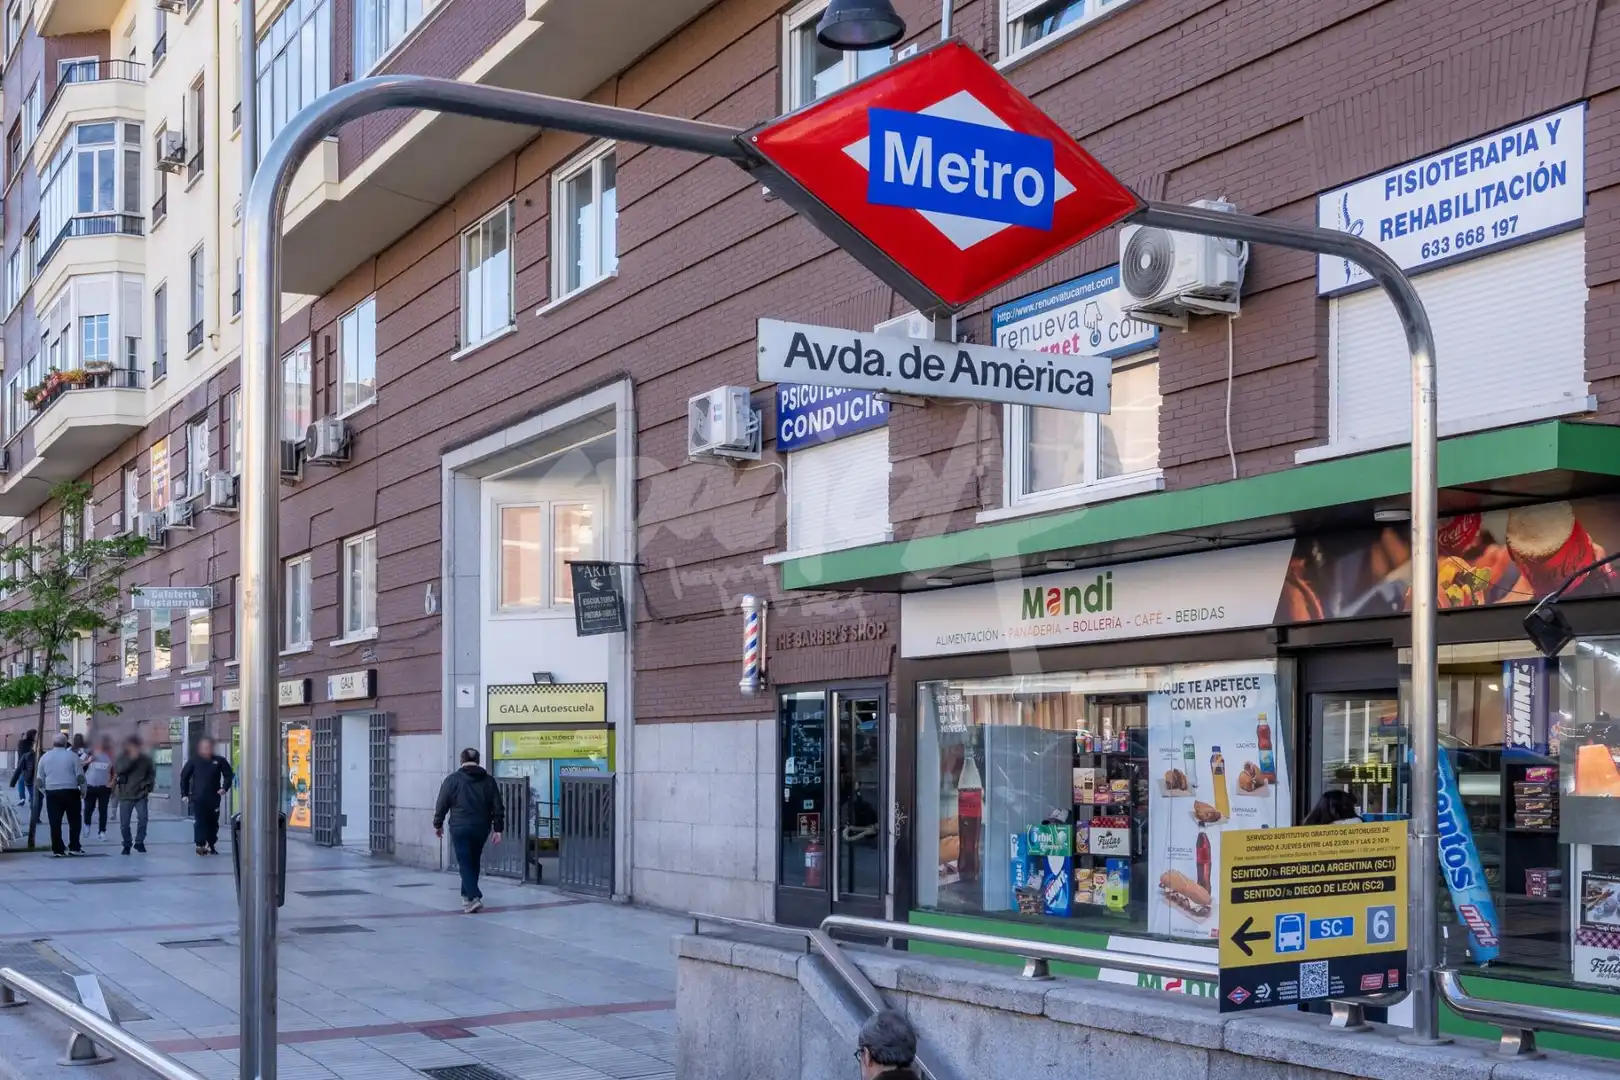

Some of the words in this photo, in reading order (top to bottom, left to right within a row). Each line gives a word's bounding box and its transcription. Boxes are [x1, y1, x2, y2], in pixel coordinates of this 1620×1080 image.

[884, 130, 1045, 207] Metro
[1385, 128, 1539, 201] FISIOTERAPIA
[1546, 118, 1562, 145] Y
[1380, 160, 1567, 242] REHABILITACIÓN
[1421, 236, 1450, 259] 633
[1455, 225, 1485, 250] 668
[1491, 214, 1519, 240] 197
[997, 275, 1114, 323] http://www.renuevatucarnet.com
[1000, 310, 1080, 350] renueva
[784, 331, 892, 378] Avda.
[899, 345, 946, 382] de
[781, 394, 885, 442] CONDUCIR
[425, 583, 437, 616] 6
[1021, 571, 1113, 621] Mandi
[850, 621, 887, 642] SHOP
[935, 628, 999, 647] ALIMENTACIÓN
[1008, 620, 1062, 640] PANADERÍA
[1134, 610, 1163, 628] CAFÉ
[1175, 605, 1226, 624] BEBIDAS
[1170, 697, 1212, 711] COMER
[1214, 695, 1247, 709] HOY?
[1188, 680, 1202, 693] TE
[1205, 677, 1260, 693] APETECE
[499, 704, 529, 714] GALA
[532, 703, 595, 714] Autoescuela
[1513, 664, 1532, 750] SMINT
[1274, 831, 1310, 840] SUSTITUTIVO
[1311, 829, 1338, 837] GRATUITO
[1348, 827, 1382, 835] AUTOBUSES
[1280, 842, 1302, 850] JUEVES
[1303, 840, 1321, 848] ENTRE
[1280, 863, 1325, 877] REPÚBLICA
[1327, 861, 1373, 872] ARGENTINA
[1374, 859, 1395, 871] (SC1)
[1294, 884, 1321, 895] DIEGO
[1323, 883, 1336, 893] DE
[1337, 880, 1360, 892] LEÓN
[1362, 880, 1384, 891] (SC2)
[1320, 919, 1343, 938] SC
[1372, 909, 1390, 940] 6
